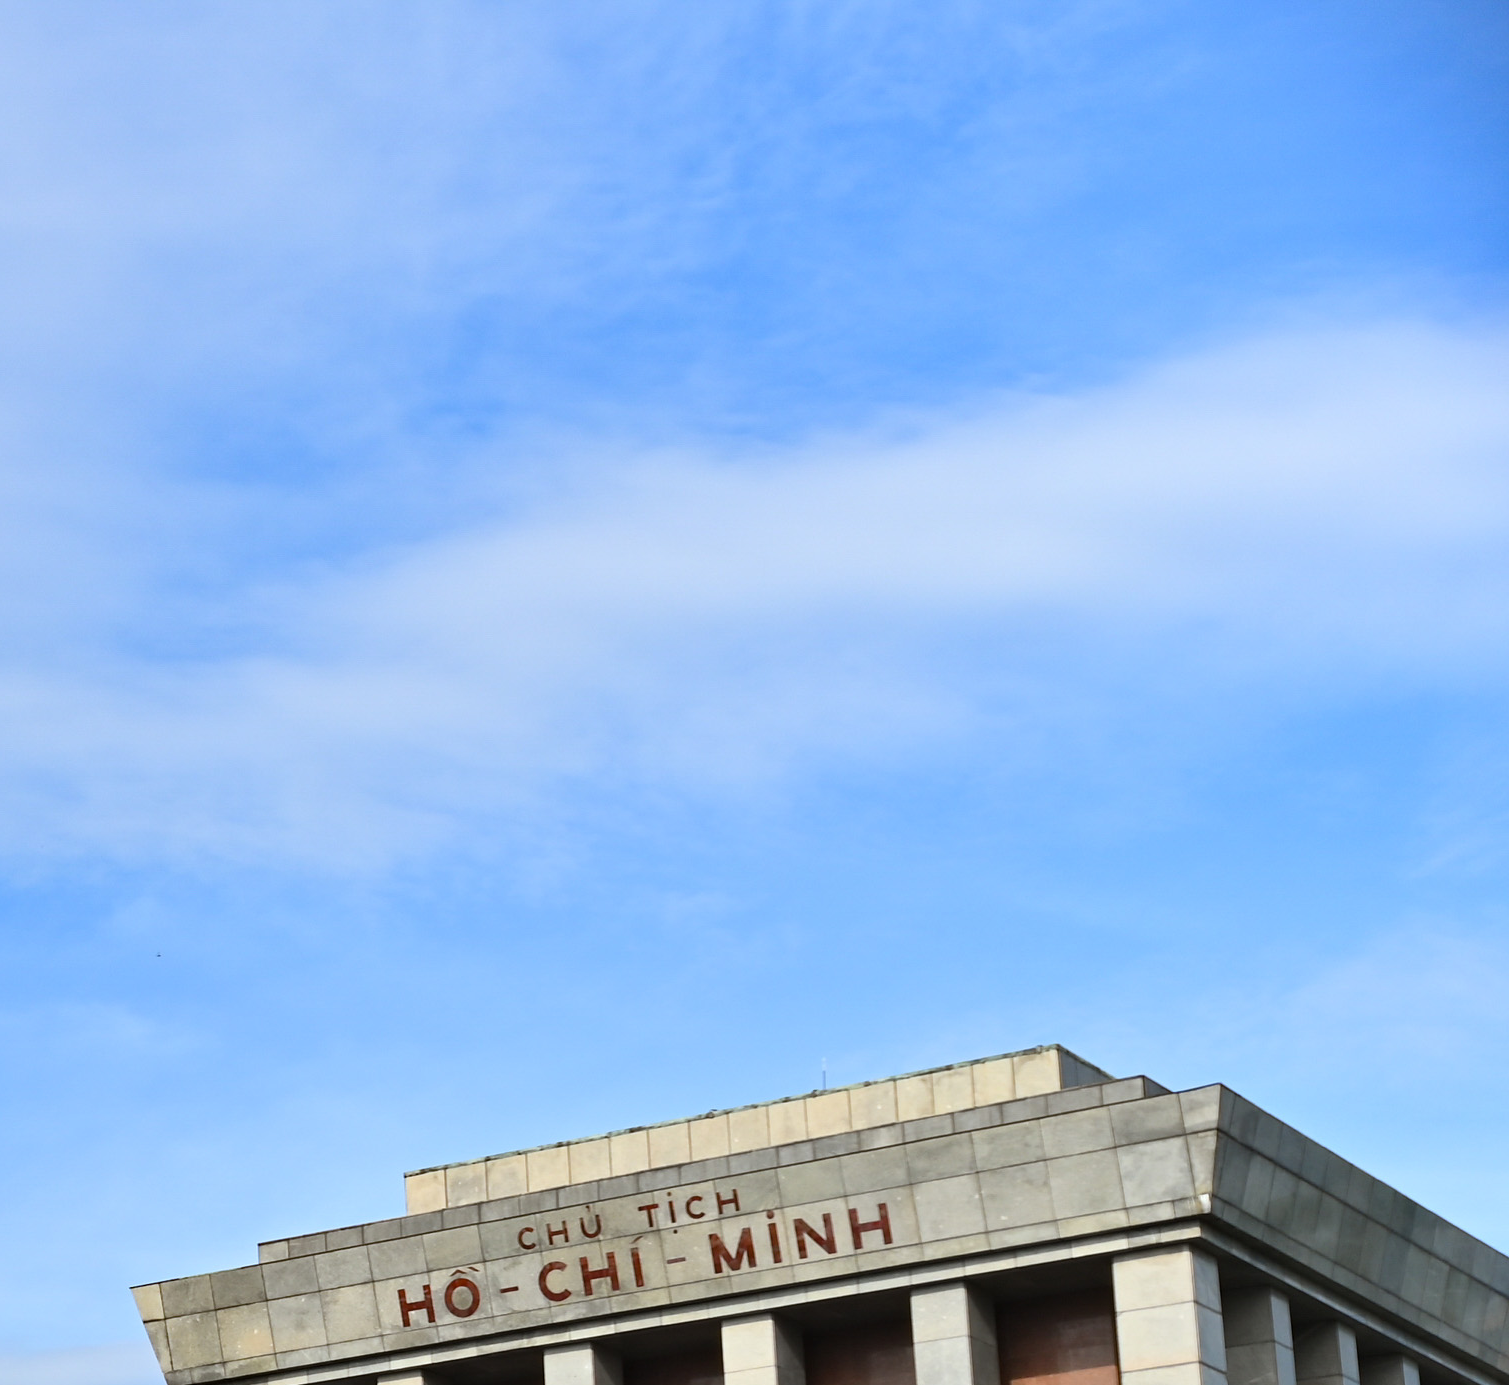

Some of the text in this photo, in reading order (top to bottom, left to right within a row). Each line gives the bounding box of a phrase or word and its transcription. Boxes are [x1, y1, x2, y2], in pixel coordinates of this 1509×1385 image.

[518, 1206, 602, 1250] CHỦ
[397, 1266, 480, 1328] HỒ
[538, 1236, 645, 1302] CHÍ
